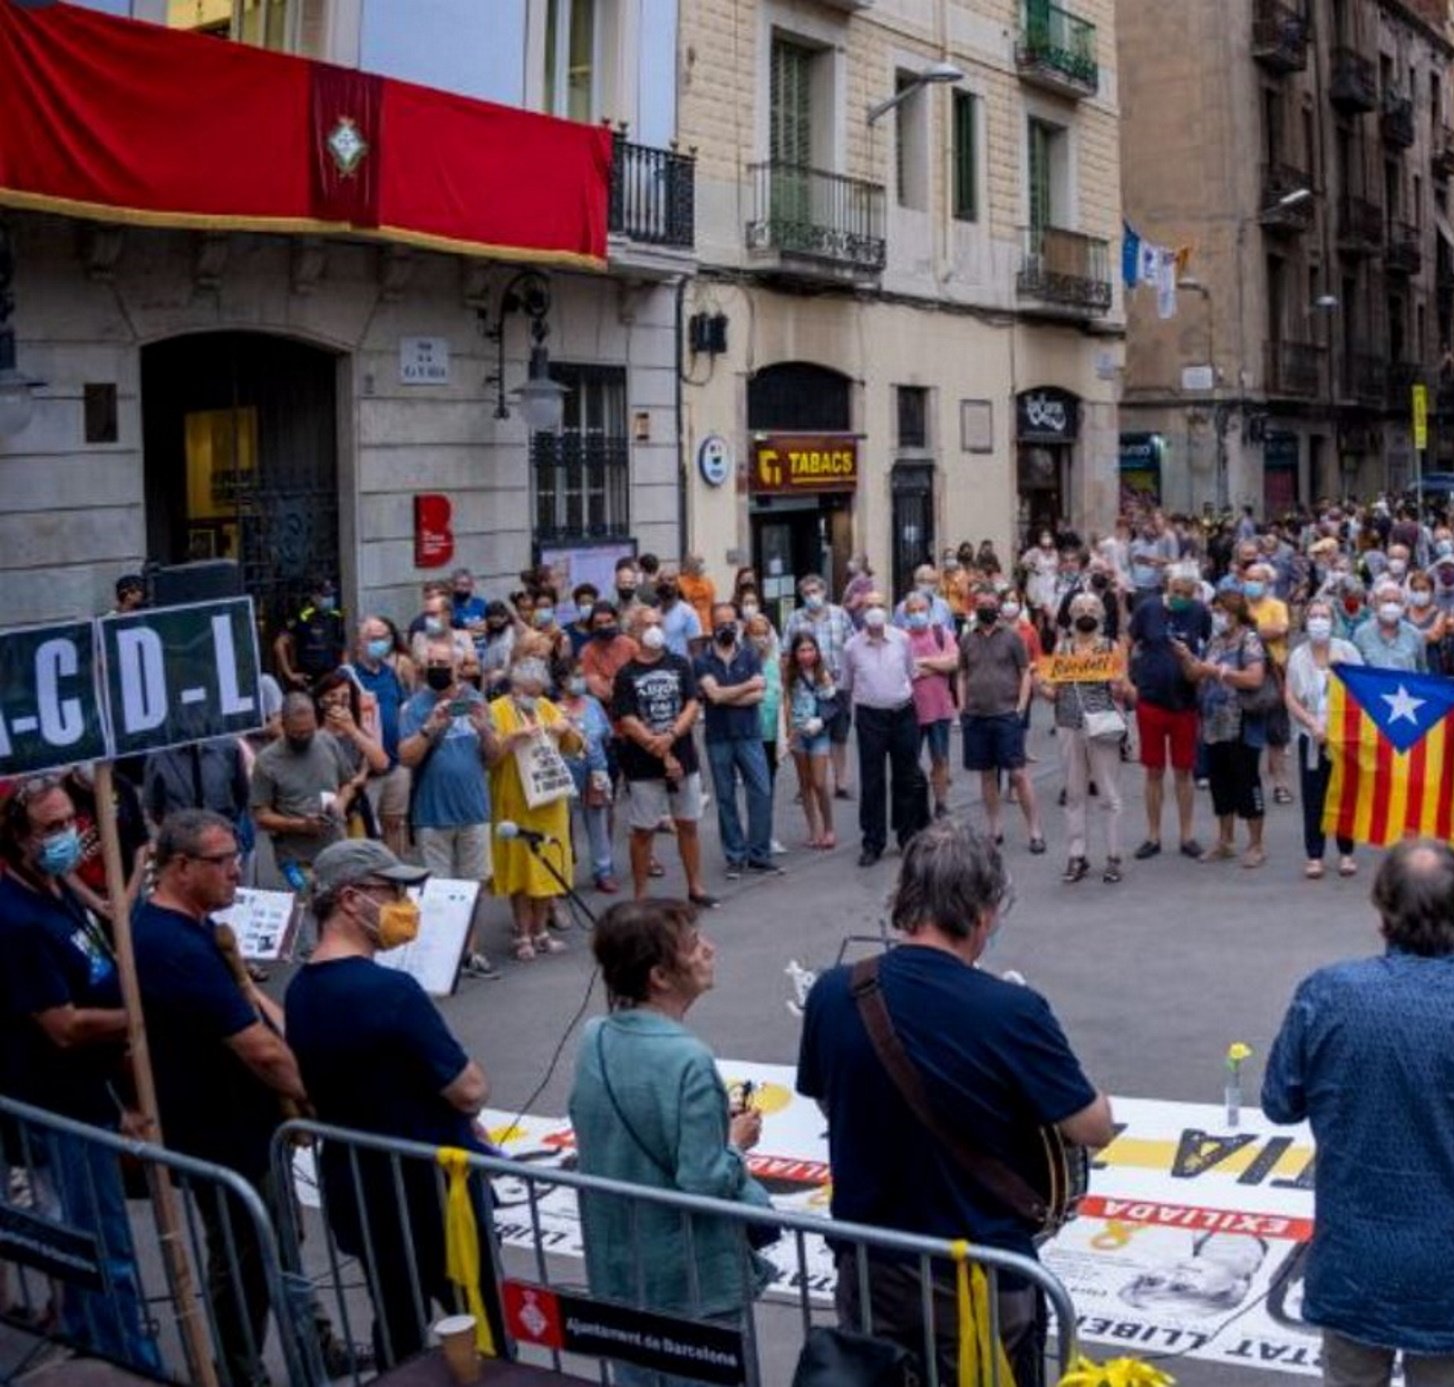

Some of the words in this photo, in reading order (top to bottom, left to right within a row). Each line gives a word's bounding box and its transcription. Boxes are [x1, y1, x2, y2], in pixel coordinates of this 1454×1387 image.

[788, 451, 854, 474] TABACS
[1102, 1199, 1293, 1234] EXILIADA
[662, 1336, 738, 1367] Barcelona
